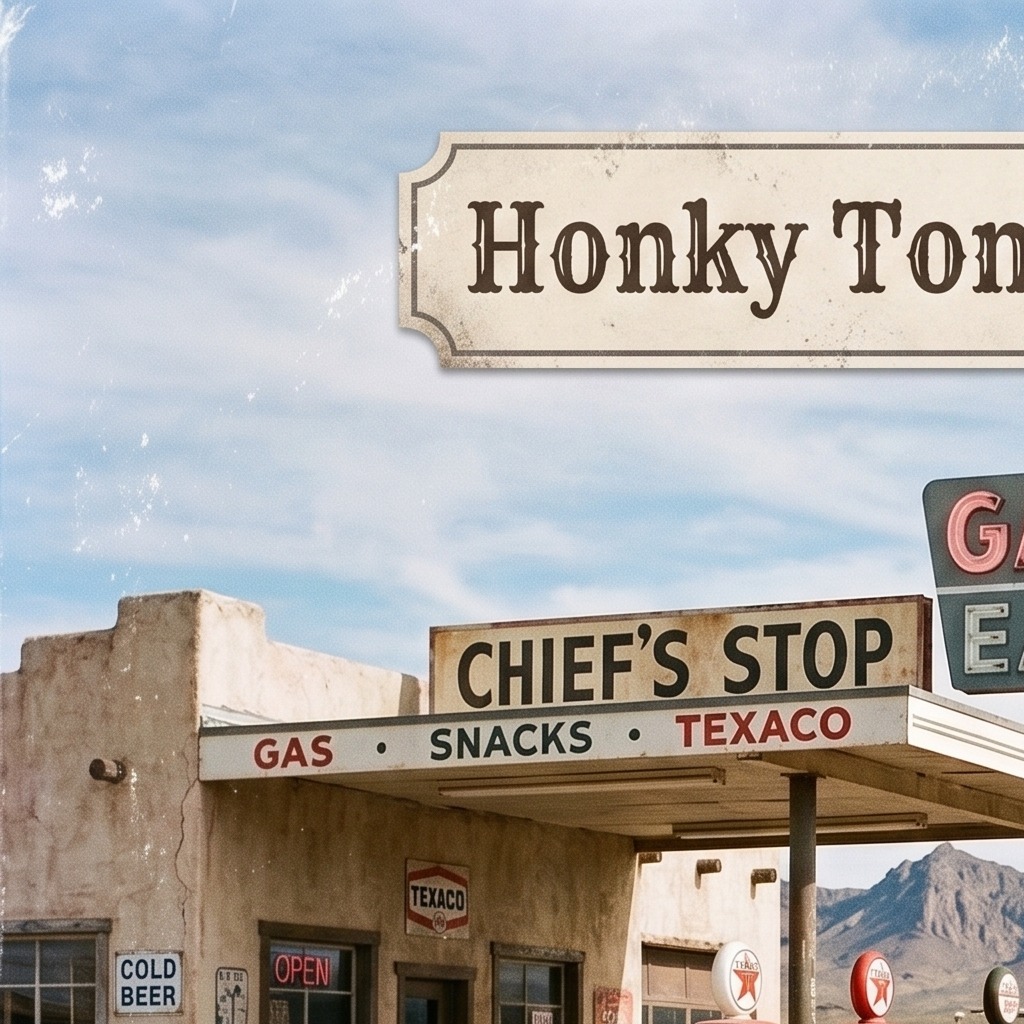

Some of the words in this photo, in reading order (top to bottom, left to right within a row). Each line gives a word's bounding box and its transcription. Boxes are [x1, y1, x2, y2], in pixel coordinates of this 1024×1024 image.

[457, 623, 690, 709] CHIEF'S
[723, 617, 893, 695] STOP
[254, 734, 333, 770] GAS
[430, 720, 593, 761] SNACKS
[675, 706, 852, 747] TEXACO
[410, 885, 465, 911] TEXACO
[120, 958, 177, 980] COLD
[274, 954, 331, 986] OPEN
[120, 985, 176, 1007] BEER
